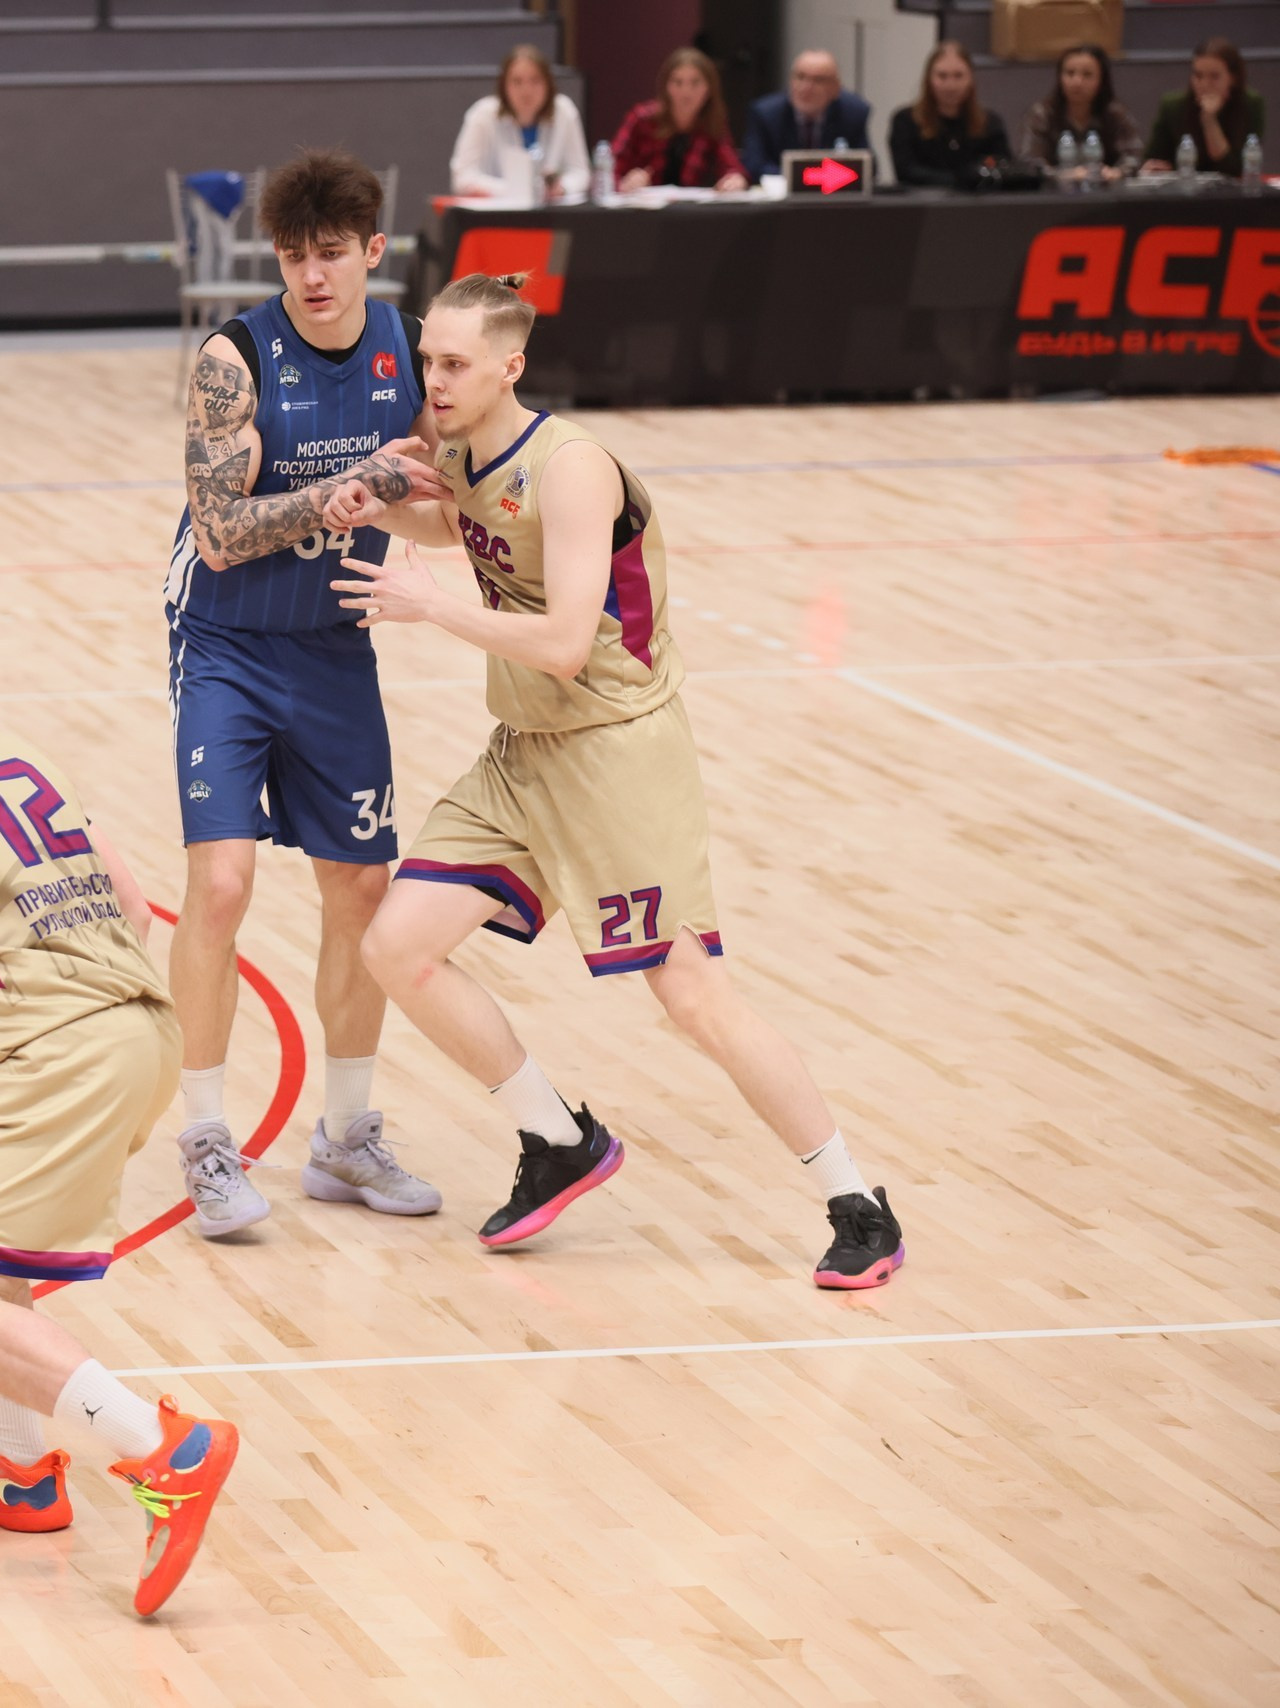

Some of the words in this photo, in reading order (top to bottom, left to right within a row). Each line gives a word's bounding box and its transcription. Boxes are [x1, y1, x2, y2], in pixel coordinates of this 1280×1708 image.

[297, 431, 380, 458] МОСКОВСКИЙ
[350, 784, 397, 841] 34
[598, 886, 662, 948] 27
